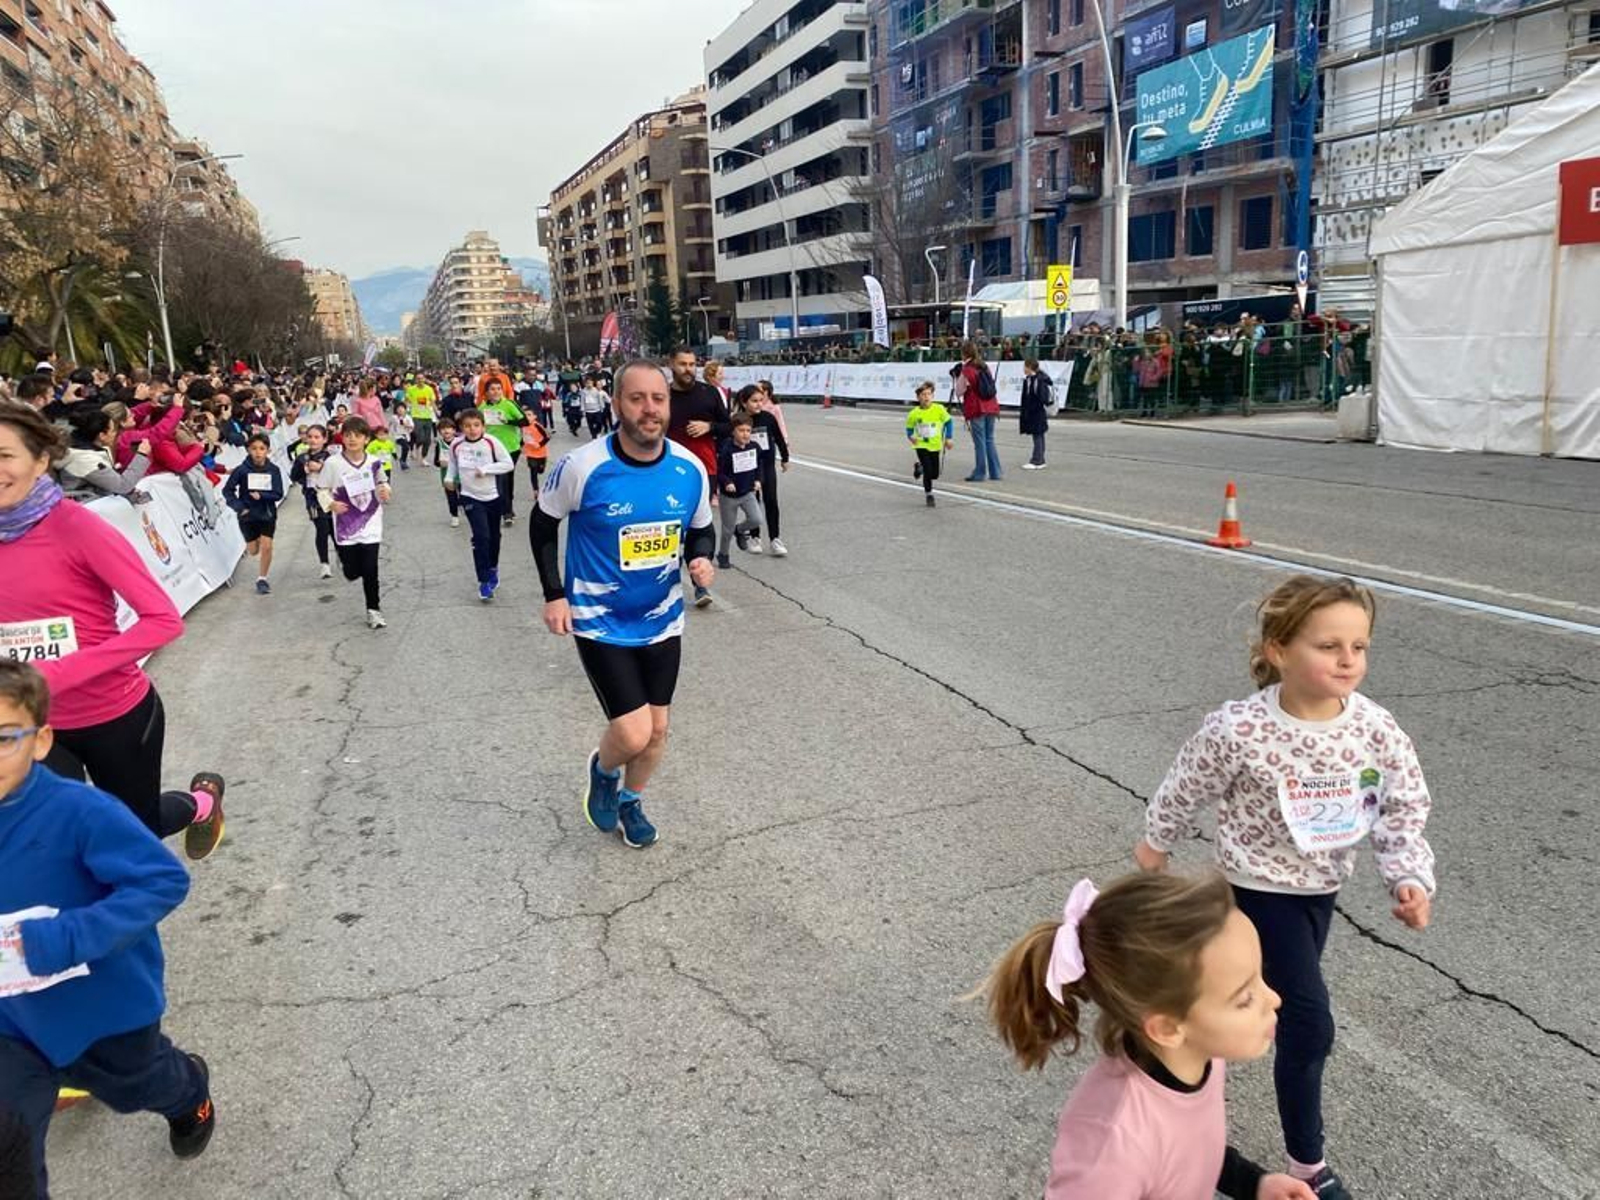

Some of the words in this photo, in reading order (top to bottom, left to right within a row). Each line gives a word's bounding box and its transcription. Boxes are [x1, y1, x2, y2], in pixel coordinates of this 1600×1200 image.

[1141, 84, 1188, 110] Destino,
[1158, 102, 1187, 121] meta
[1233, 117, 1267, 135] CULMIA
[633, 538, 670, 554] 5350
[8, 642, 61, 662] 8784
[1301, 779, 1337, 789] NOCHE
[1288, 789, 1312, 801] SAN
